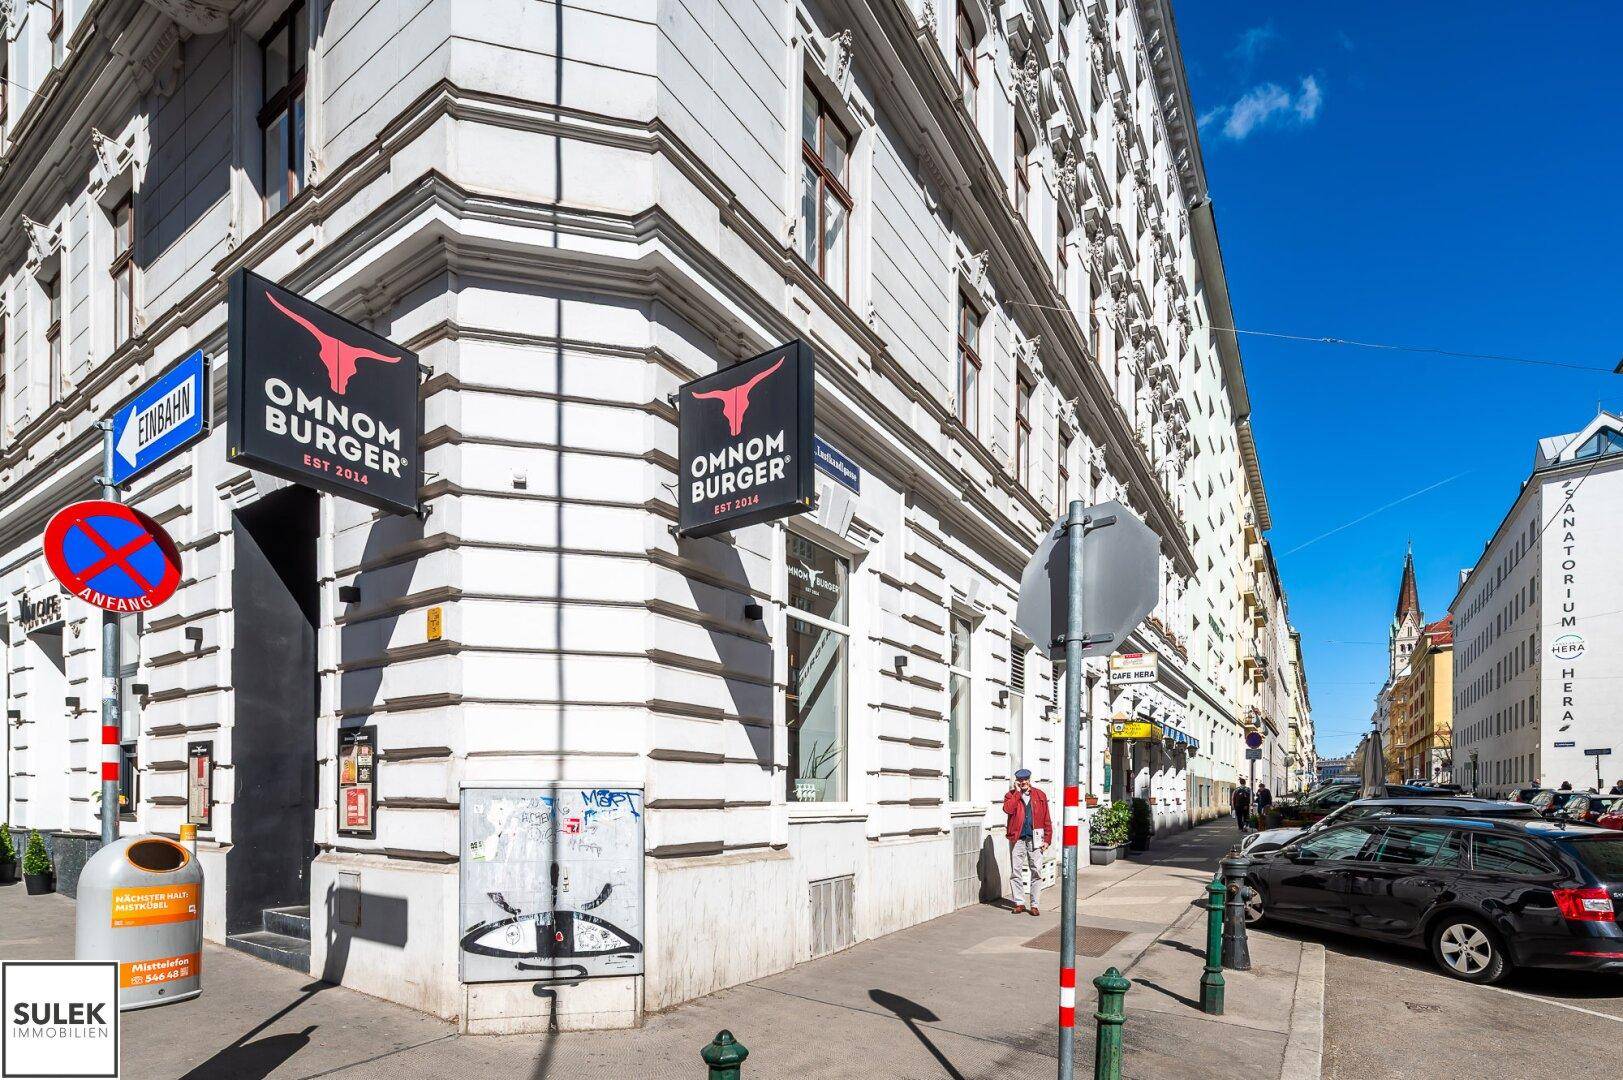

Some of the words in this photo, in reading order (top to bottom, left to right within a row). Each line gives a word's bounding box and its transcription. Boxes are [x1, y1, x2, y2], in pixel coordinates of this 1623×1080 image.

[138, 382, 190, 447] EINBAHN
[265, 378, 400, 450] OMNOM
[691, 430, 784, 477] OMNOM
[304, 453, 330, 472] EST
[336, 466, 369, 485] 2014
[714, 503, 732, 515] EST
[735, 494, 760, 509] 2014
[1562, 489, 1576, 627] SANATORIUM
[787, 565, 809, 581] MNOM
[78, 587, 153, 611] ANFANG
[1551, 644, 1585, 654] HERA
[1112, 672, 1131, 680] CAFE
[1134, 670, 1155, 679] HERA
[1562, 668, 1574, 721] HERA
[116, 894, 165, 903] NÄCHSTER
[116, 902, 168, 911] MISTKÜBEL
[132, 958, 189, 973] Misttelefon
[145, 973, 165, 983] 546
[167, 970, 179, 979] 48
